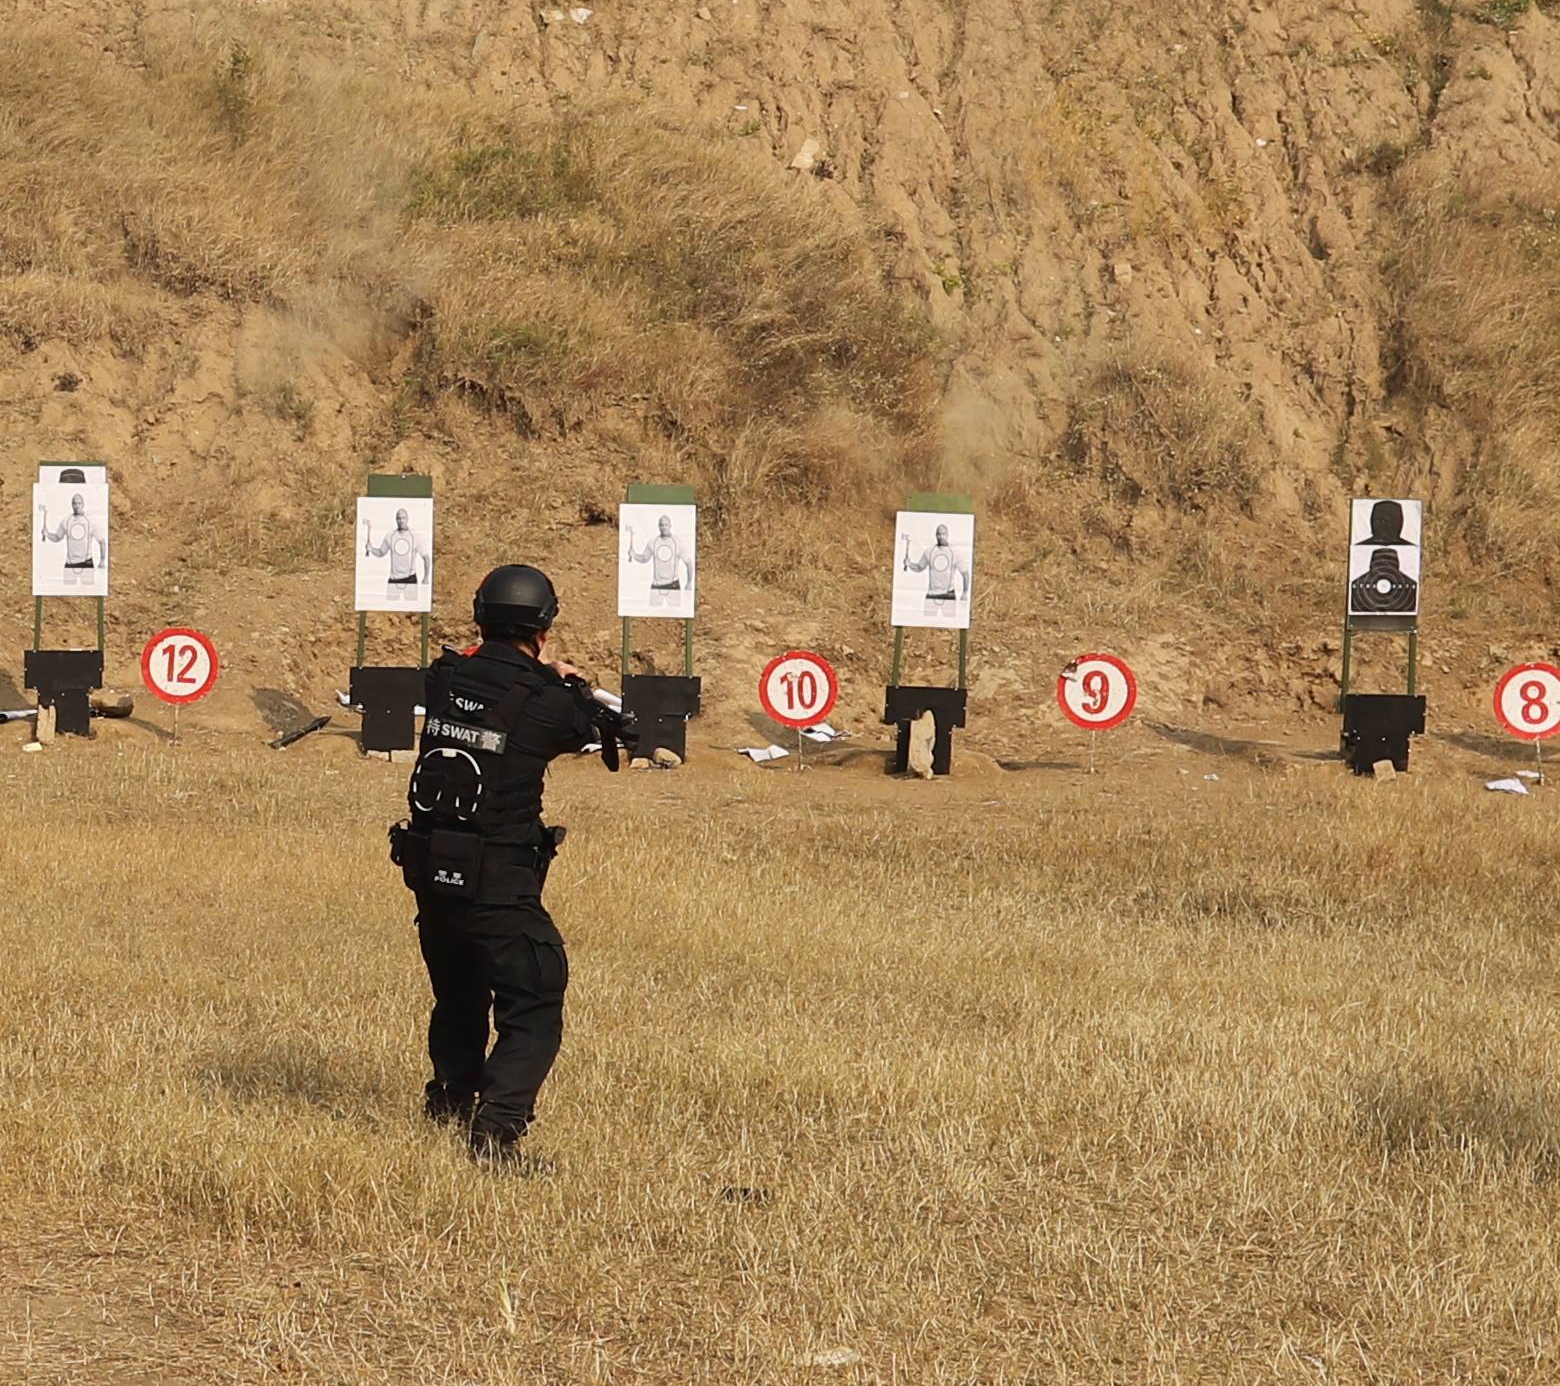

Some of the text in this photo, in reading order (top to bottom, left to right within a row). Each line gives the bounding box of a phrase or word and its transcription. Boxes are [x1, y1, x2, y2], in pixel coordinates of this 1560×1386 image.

[162, 644, 198, 684] 12
[779, 670, 818, 710] 10
[1082, 669, 1110, 715] 9
[1520, 680, 1550, 725] 8
[441, 723, 480, 743] SWAT
